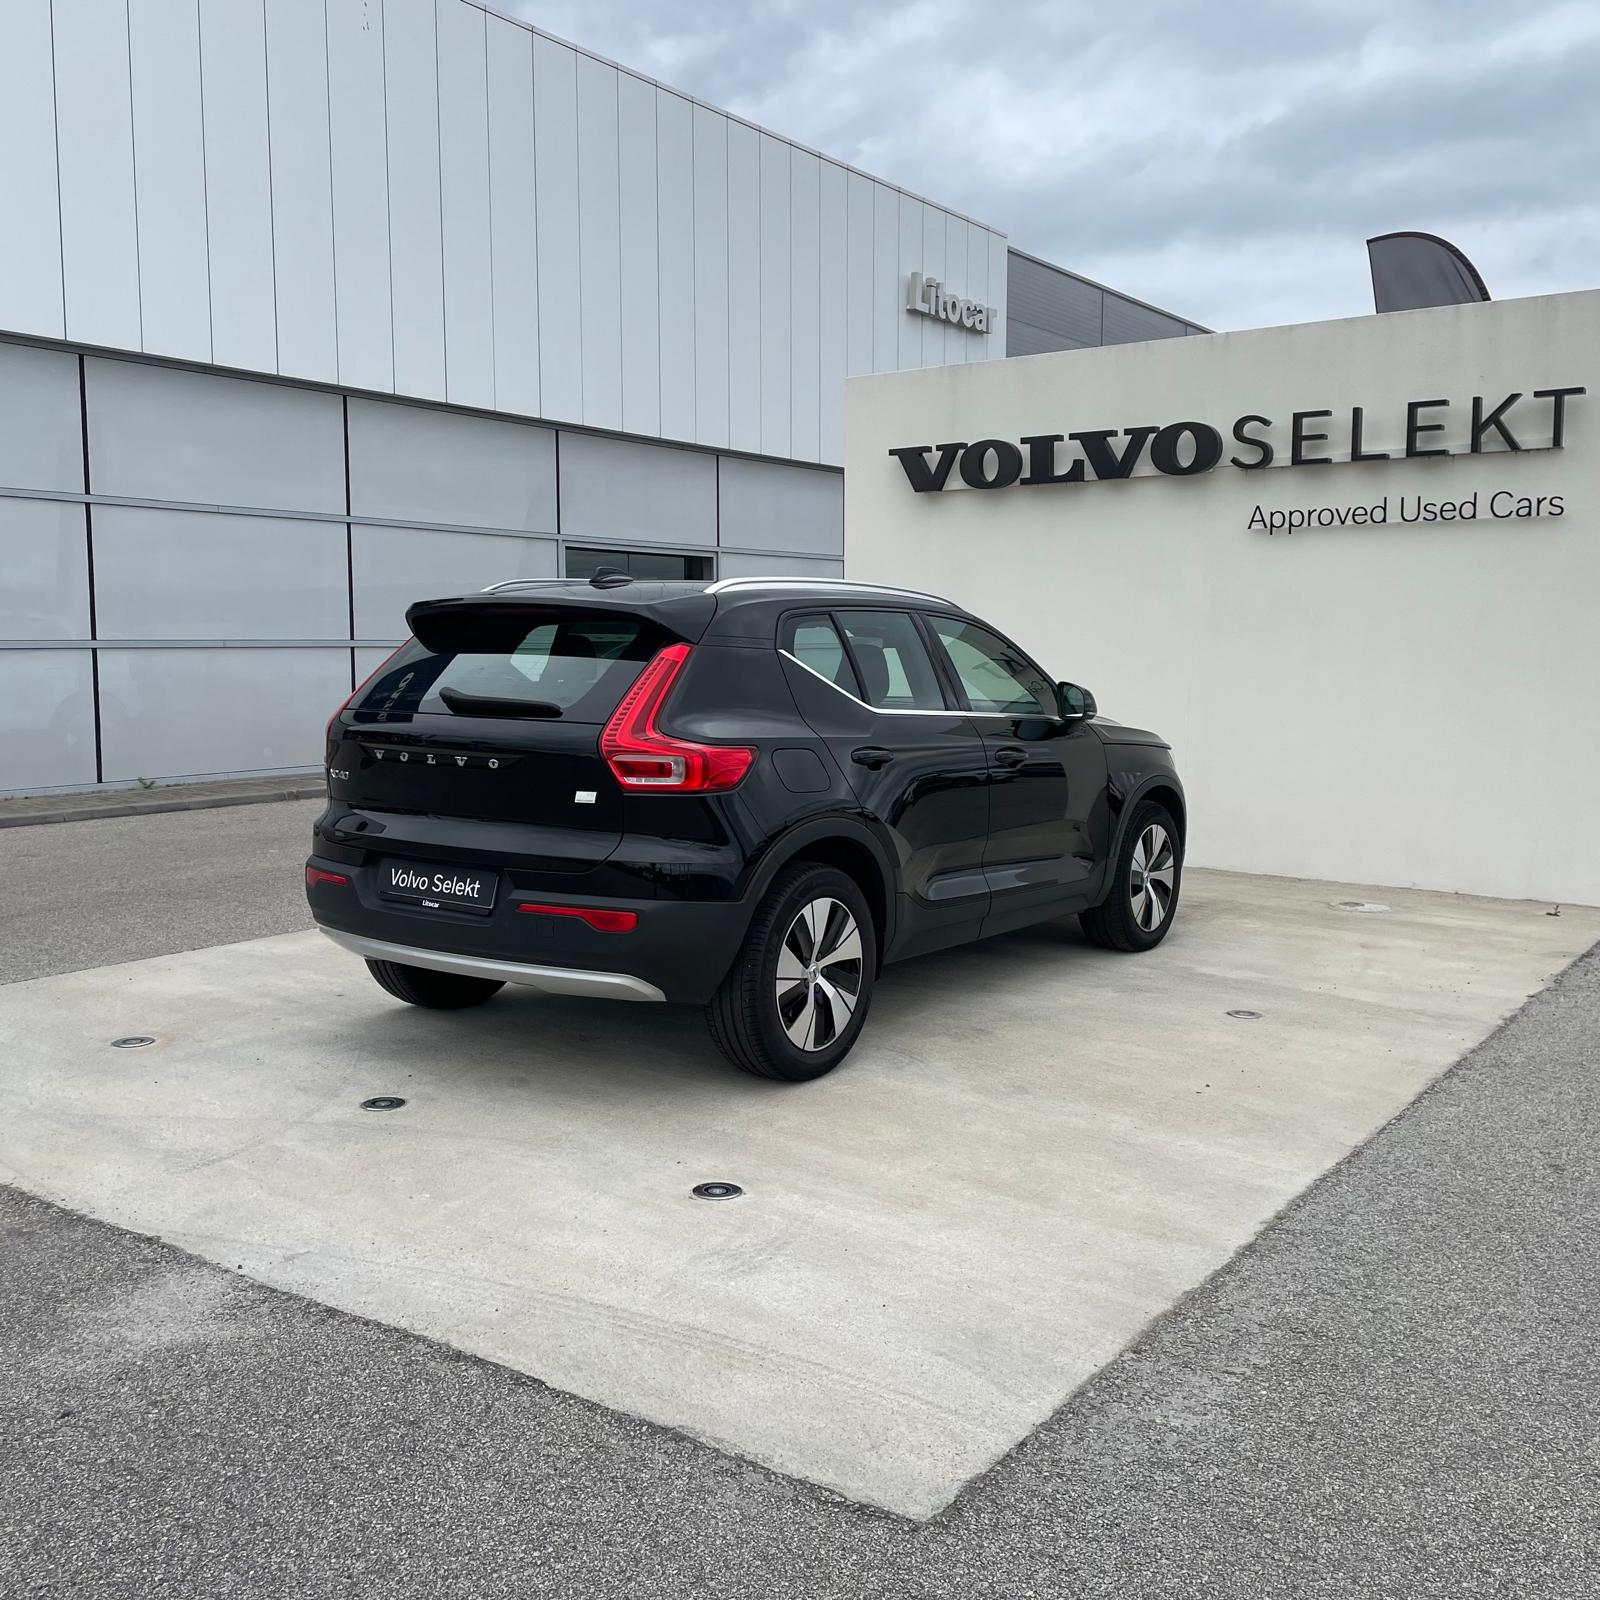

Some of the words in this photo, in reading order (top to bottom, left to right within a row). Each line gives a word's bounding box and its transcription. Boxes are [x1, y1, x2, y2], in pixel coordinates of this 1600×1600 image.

[906, 271, 998, 335] Litocar
[1247, 495, 1388, 535] Approved
[1400, 491, 1478, 523] Used
[1489, 490, 1565, 519] Cars
[374, 750, 499, 769] VOLVO
[391, 868, 428, 890] Volvo
[431, 874, 480, 898] Selekt
